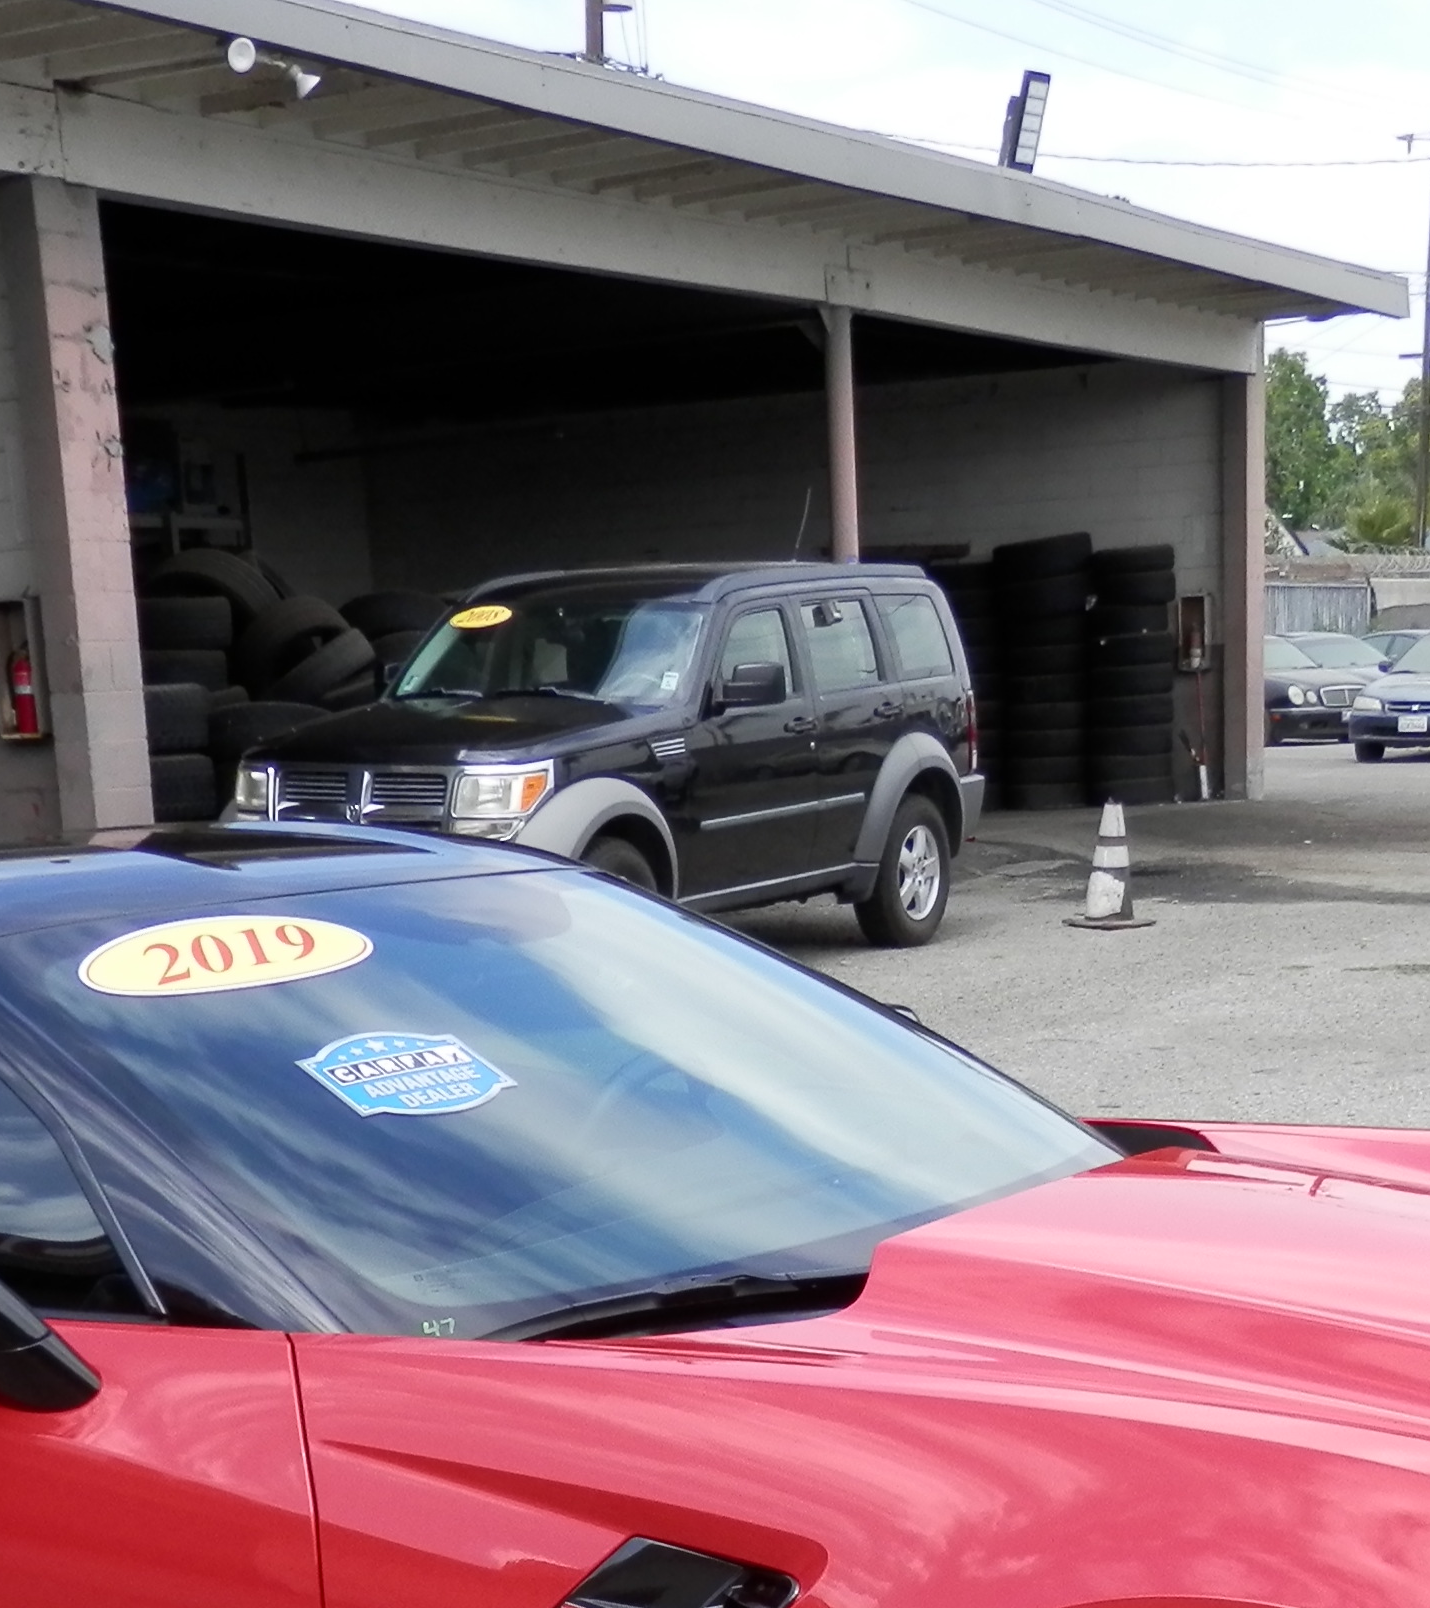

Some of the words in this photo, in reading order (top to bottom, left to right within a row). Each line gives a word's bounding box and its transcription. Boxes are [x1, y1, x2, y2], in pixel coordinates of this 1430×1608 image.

[143, 924, 315, 986] 2019
[331, 1049, 467, 1083] CARFAX
[363, 1065, 482, 1099] ADVANTAGE
[399, 1082, 481, 1108] DEALER
[422, 1317, 455, 1337] 47
